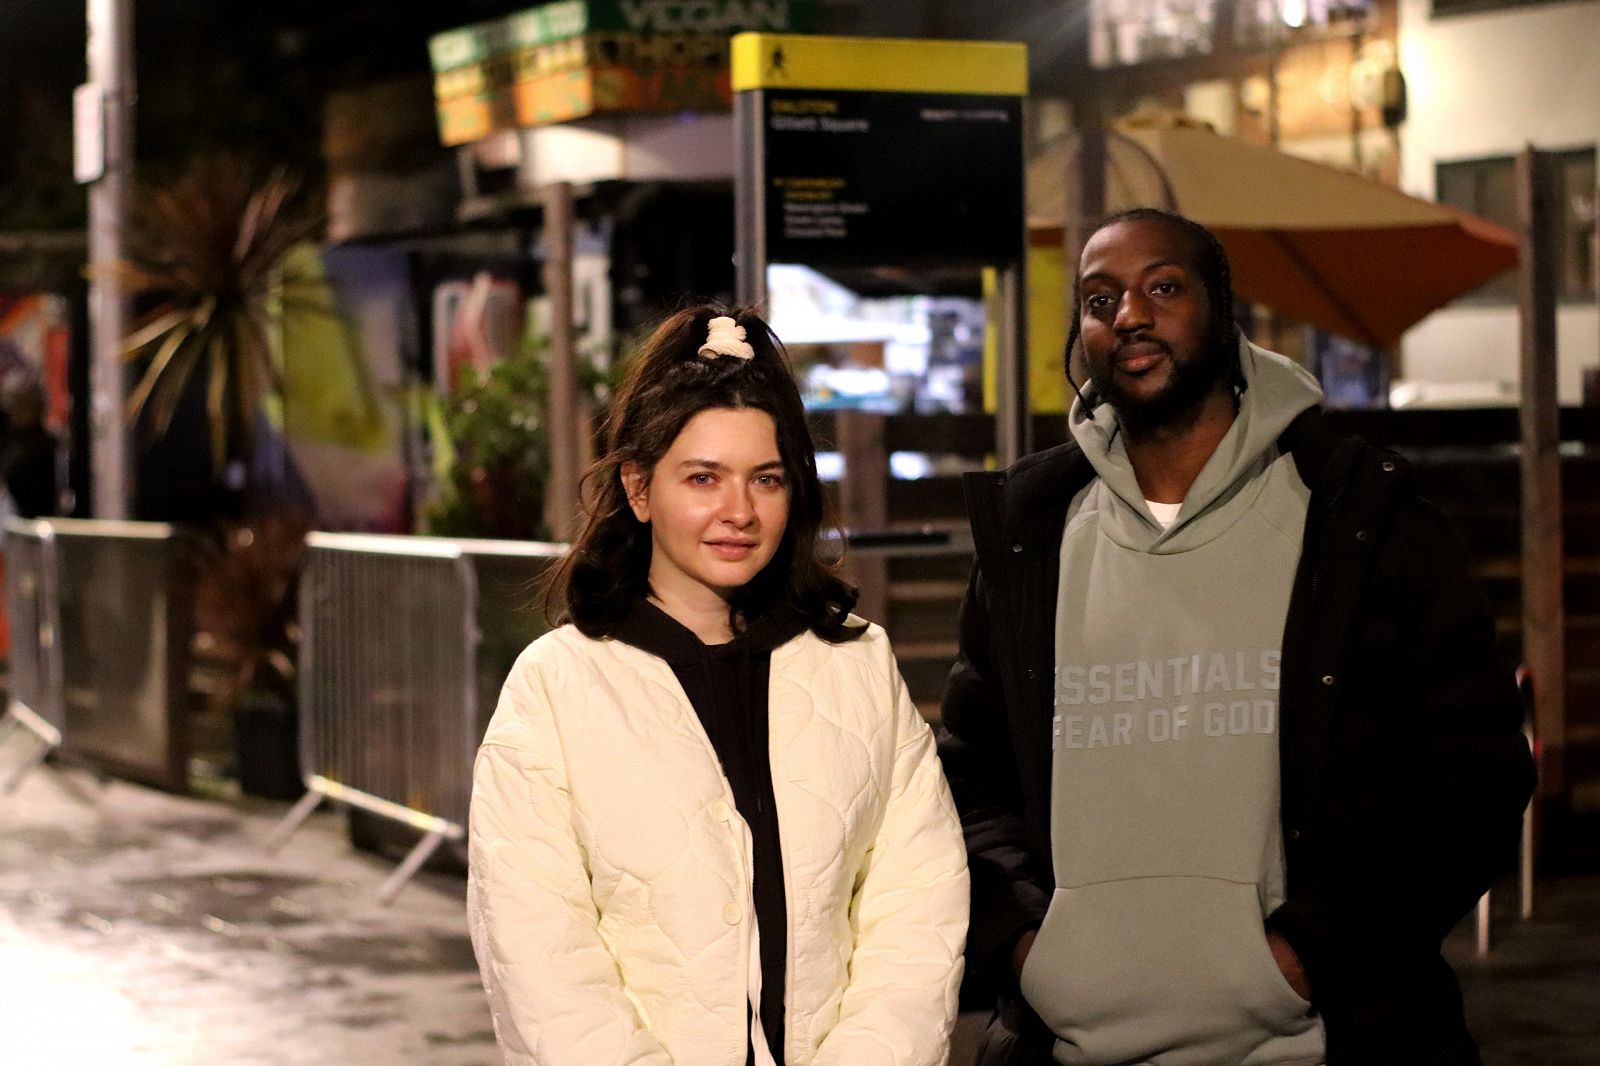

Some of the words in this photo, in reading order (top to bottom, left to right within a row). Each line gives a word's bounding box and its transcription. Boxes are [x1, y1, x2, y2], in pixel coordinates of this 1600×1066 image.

[620, 0, 789, 30] VEGAN
[1054, 650, 1281, 705] SSENTIALS
[1148, 704, 1190, 743] OF
[1203, 700, 1275, 737] GOD
